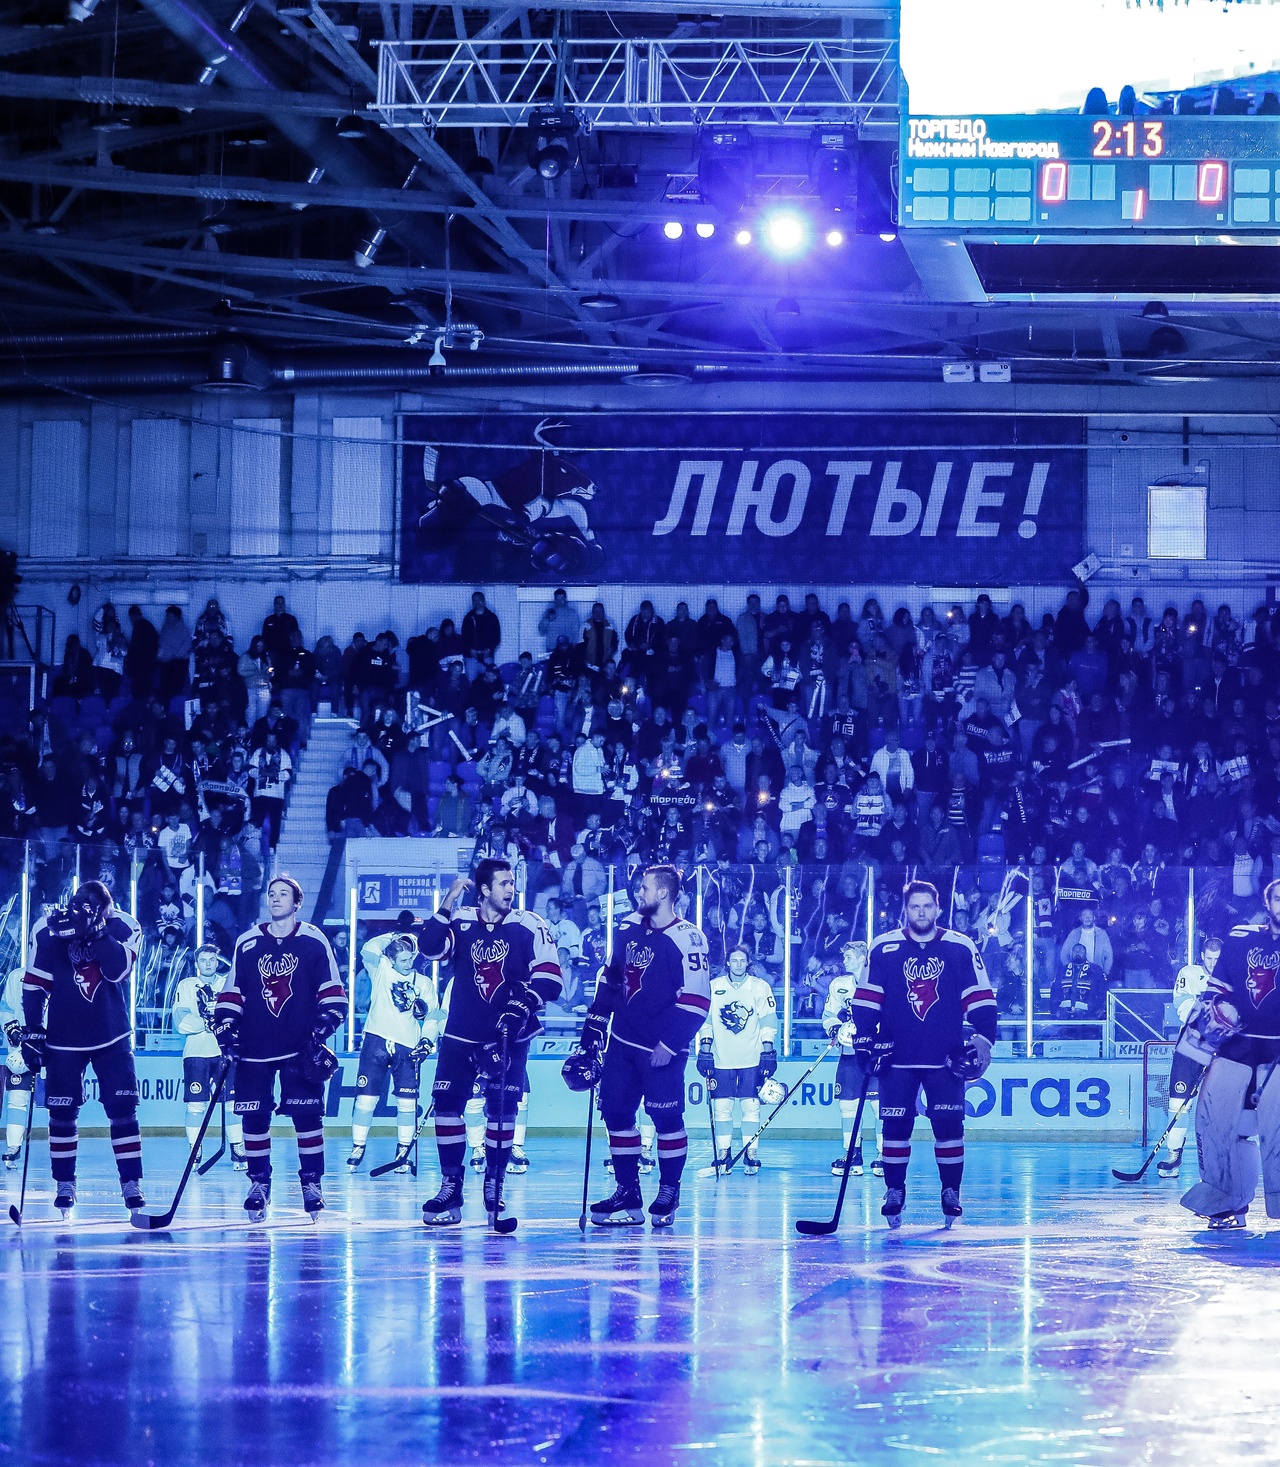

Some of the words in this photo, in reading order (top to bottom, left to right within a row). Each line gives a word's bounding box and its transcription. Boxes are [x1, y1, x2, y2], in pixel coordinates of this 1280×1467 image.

[908, 119, 986, 142] ТОРПЕДО
[1092, 120, 1163, 157] 2:13
[1041, 162, 1067, 201] 0
[1198, 163, 1224, 201] 0
[653, 459, 1050, 539] ЛЮТЫЕ!
